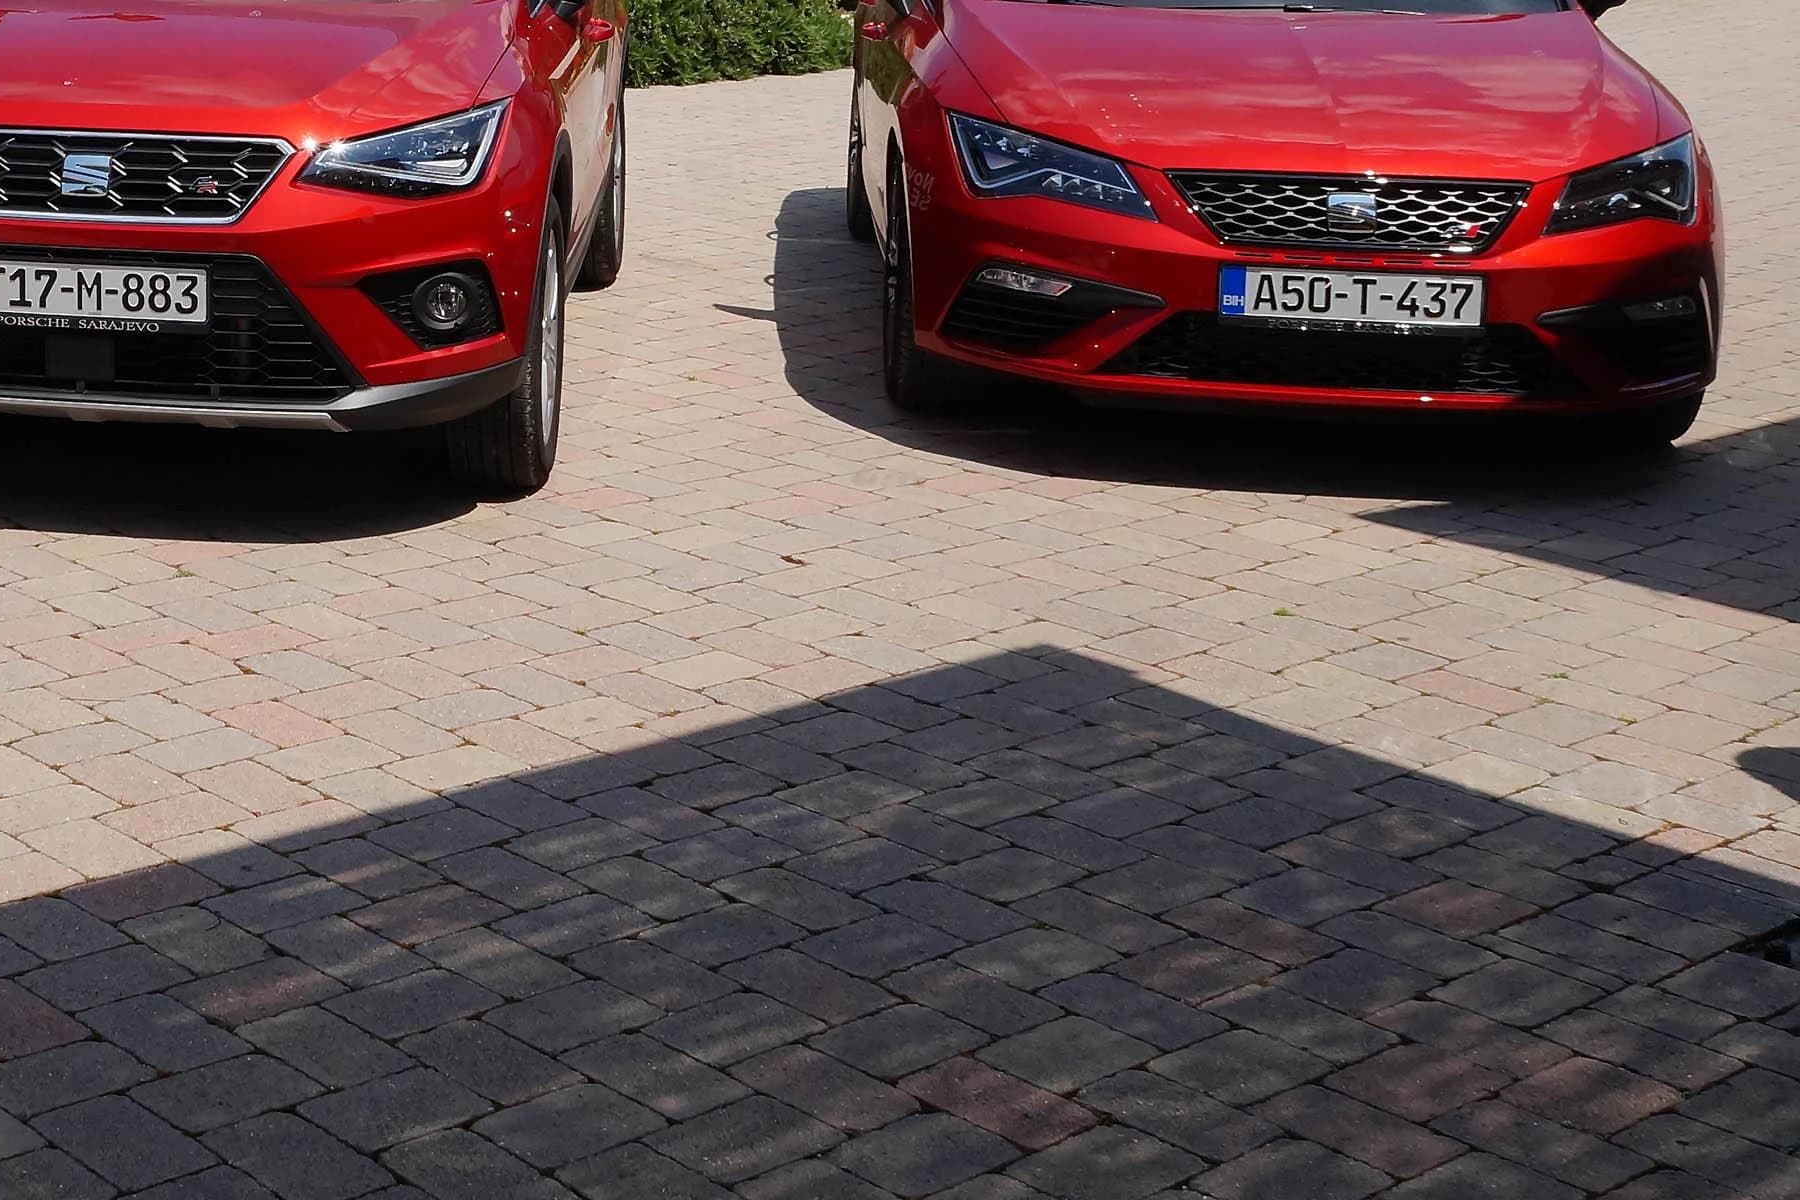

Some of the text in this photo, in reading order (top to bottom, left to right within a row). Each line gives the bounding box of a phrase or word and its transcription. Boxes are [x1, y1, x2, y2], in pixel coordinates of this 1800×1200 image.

[1223, 274, 1475, 320] BIH A50-T-437
[78, 319, 160, 333] SARAJEVO
